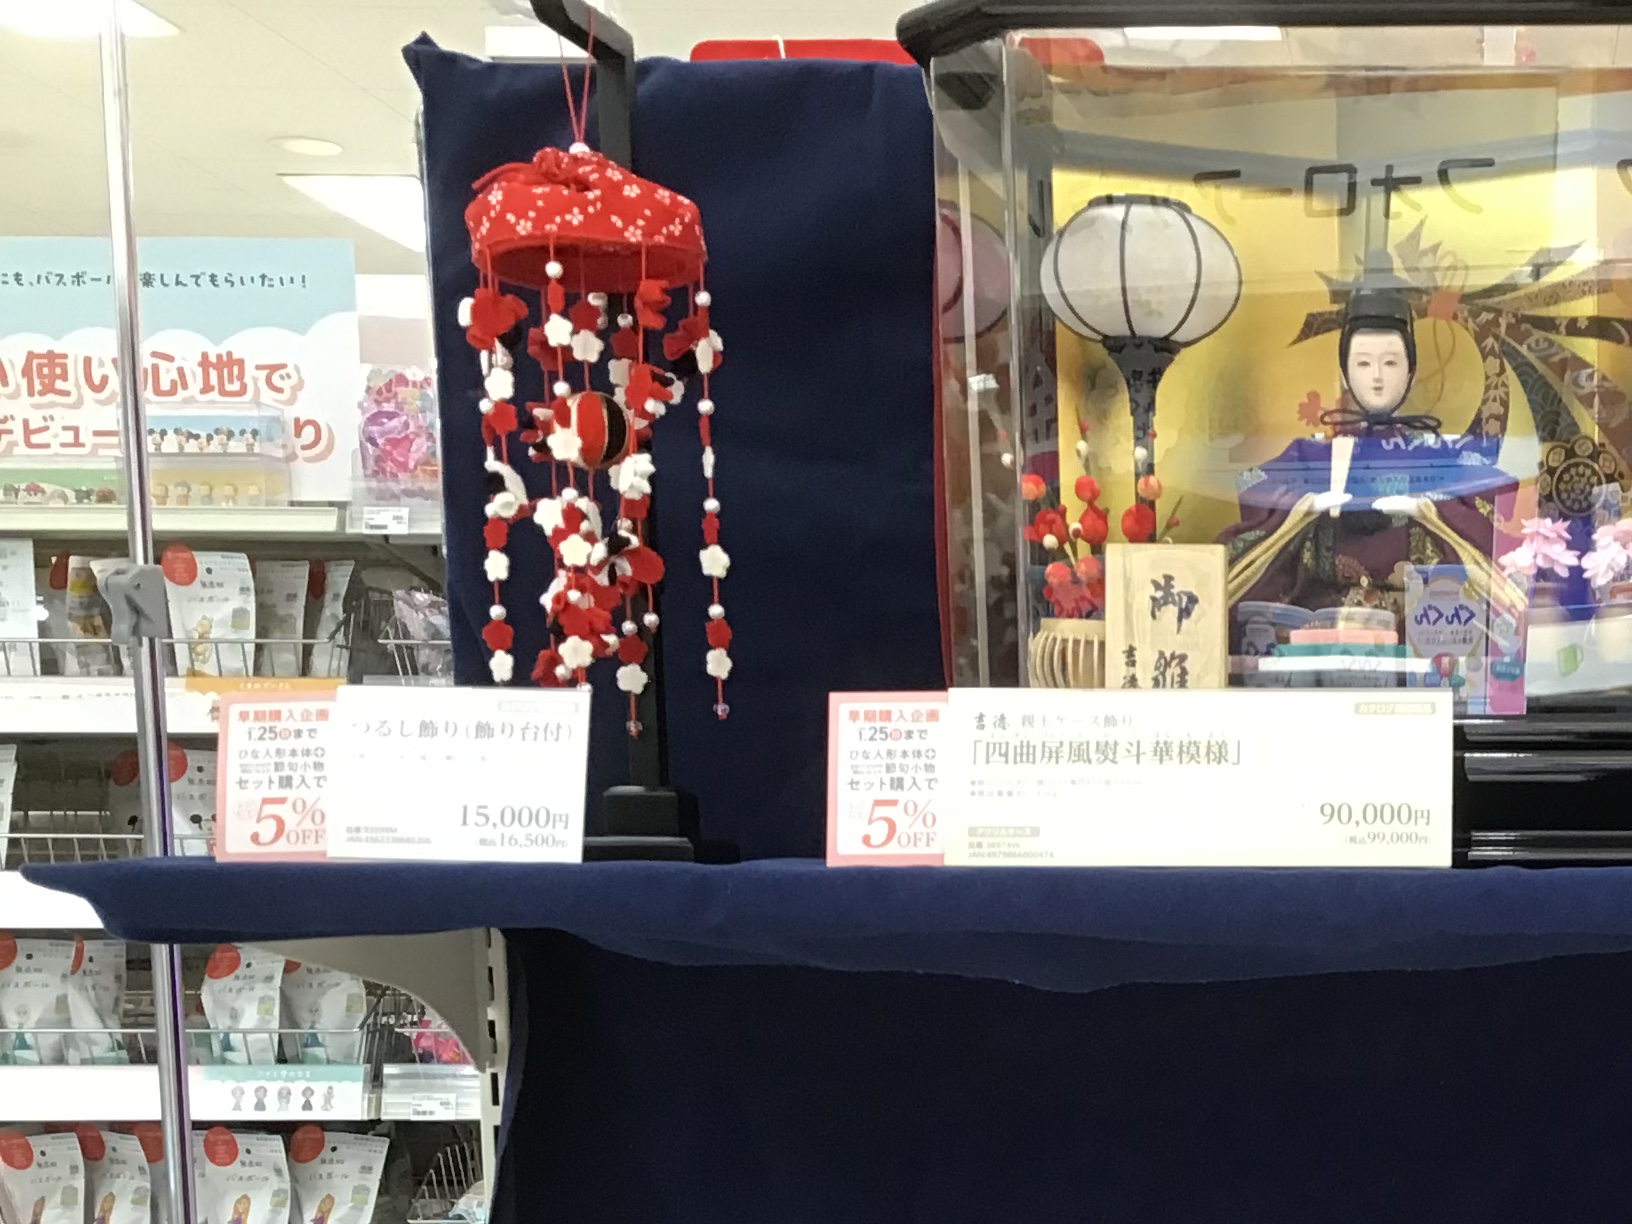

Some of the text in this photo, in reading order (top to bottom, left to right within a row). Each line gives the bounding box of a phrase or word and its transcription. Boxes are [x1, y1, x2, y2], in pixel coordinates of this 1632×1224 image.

[237, 708, 329, 723] 早期購入企画
[848, 710, 940, 724] 早期購入企画
[238, 747, 313, 760] ひな人形本体
[849, 748, 924, 761] ひな人形本体
[885, 763, 936, 776] 節句小物
[235, 774, 329, 790] セット購入で
[847, 776, 940, 793] セット購入で
[250, 796, 327, 847] 5%
[459, 804, 569, 830] 15,000円
[1319, 802, 1431, 828] 90,000円
[861, 798, 937, 850] 5%
[285, 829, 327, 846] OFF
[897, 831, 938, 849] OFF
